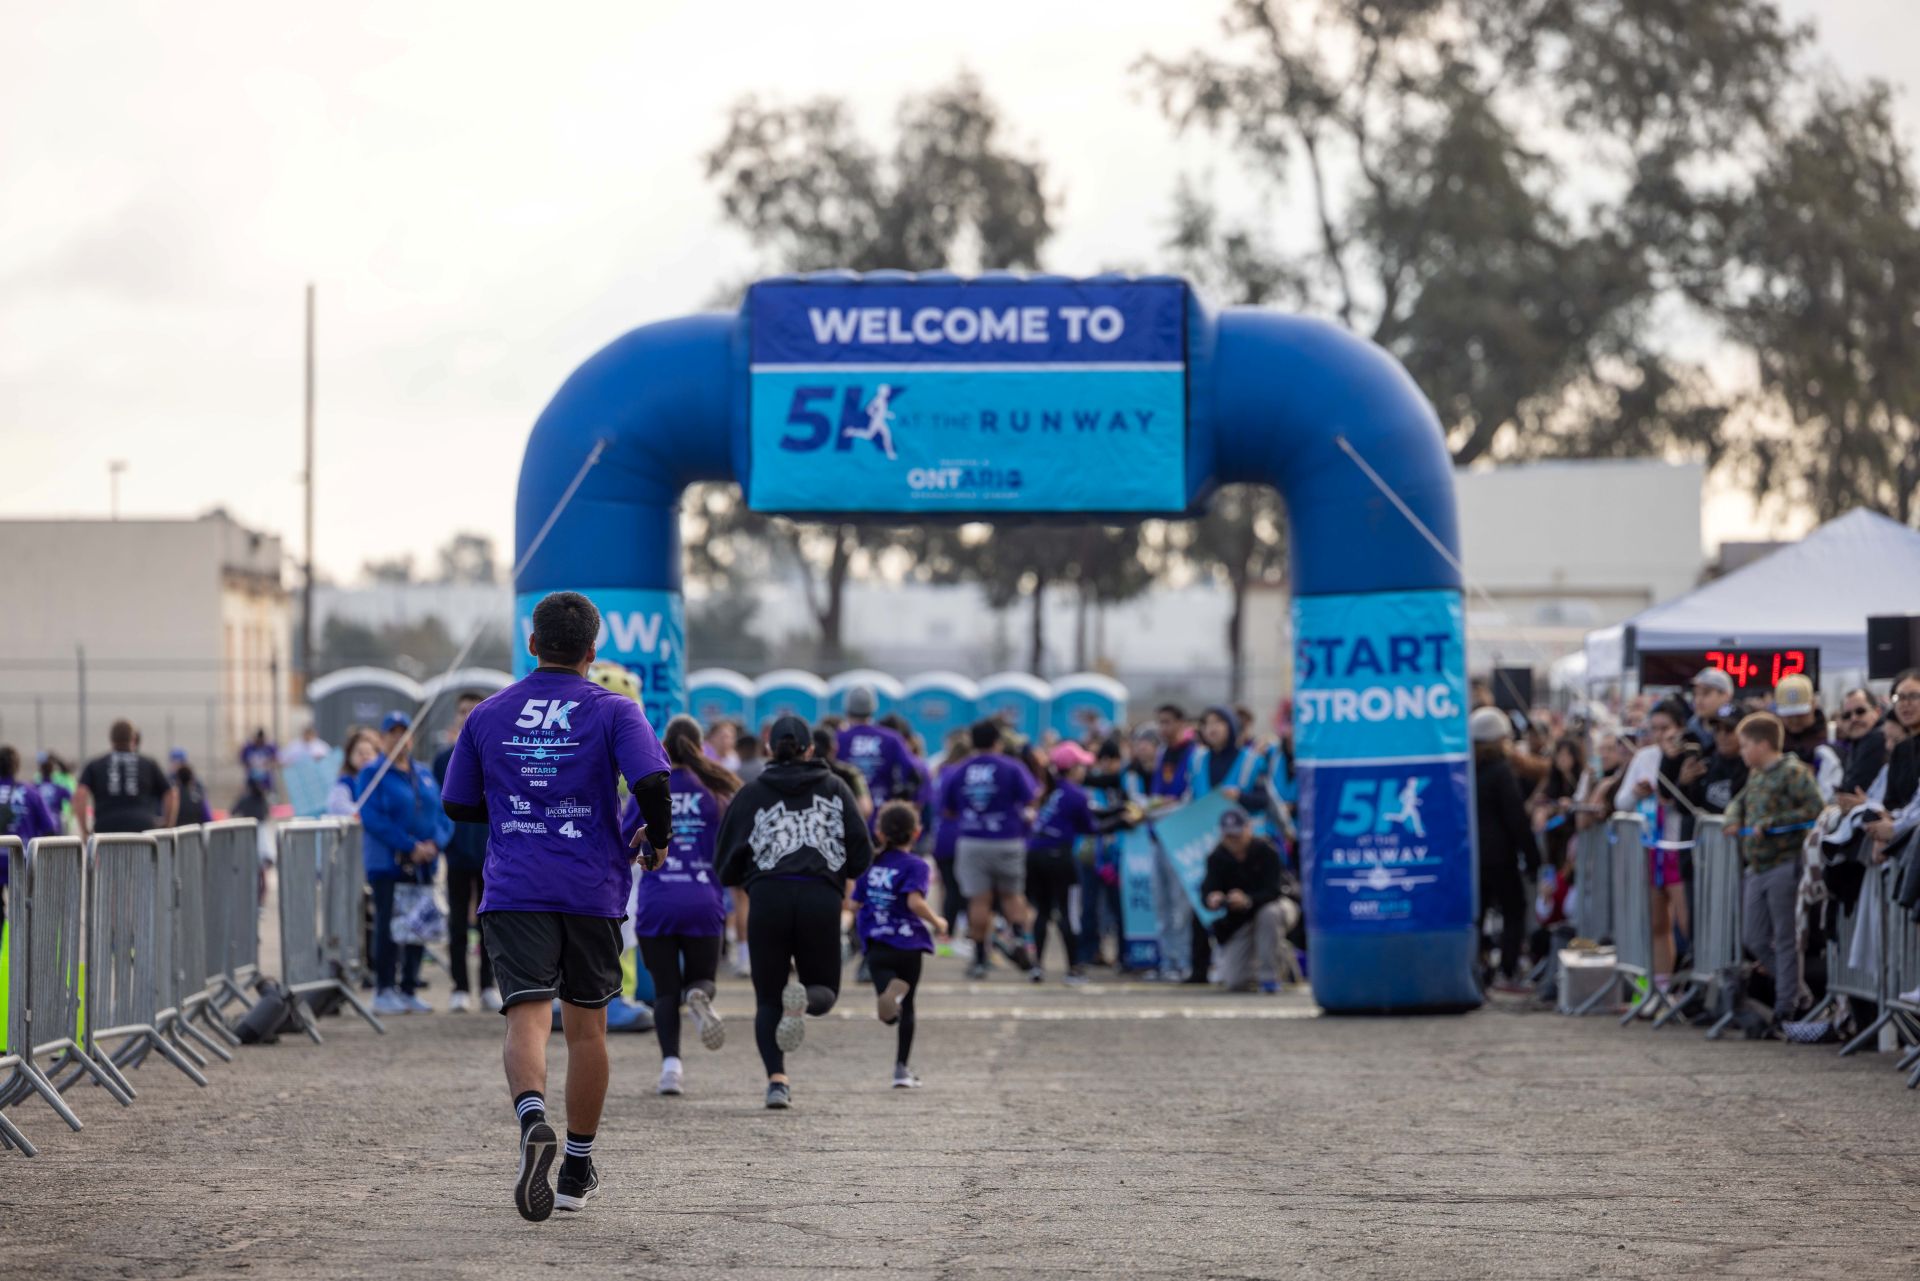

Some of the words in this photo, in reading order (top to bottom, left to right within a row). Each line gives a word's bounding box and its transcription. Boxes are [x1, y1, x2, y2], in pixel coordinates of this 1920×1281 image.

[808, 307, 1049, 344] WELCOME
[1059, 307, 1125, 343] TO
[779, 386, 905, 454] 5K
[980, 410, 1155, 433] RUNWAY
[1297, 634, 1450, 679] START
[515, 699, 580, 730] 5K
[1297, 684, 1459, 724] STRONG.
[512, 736, 570, 745] RUNWAY
[547, 807, 567, 815] JACOB
[671, 792, 703, 814] 5K
[1333, 777, 1432, 836] 5K
[501, 821, 512, 830] SAN
[518, 821, 547, 830] MANUEL
[1332, 845, 1428, 865] RUNWAY
[867, 866, 899, 889] 5K
